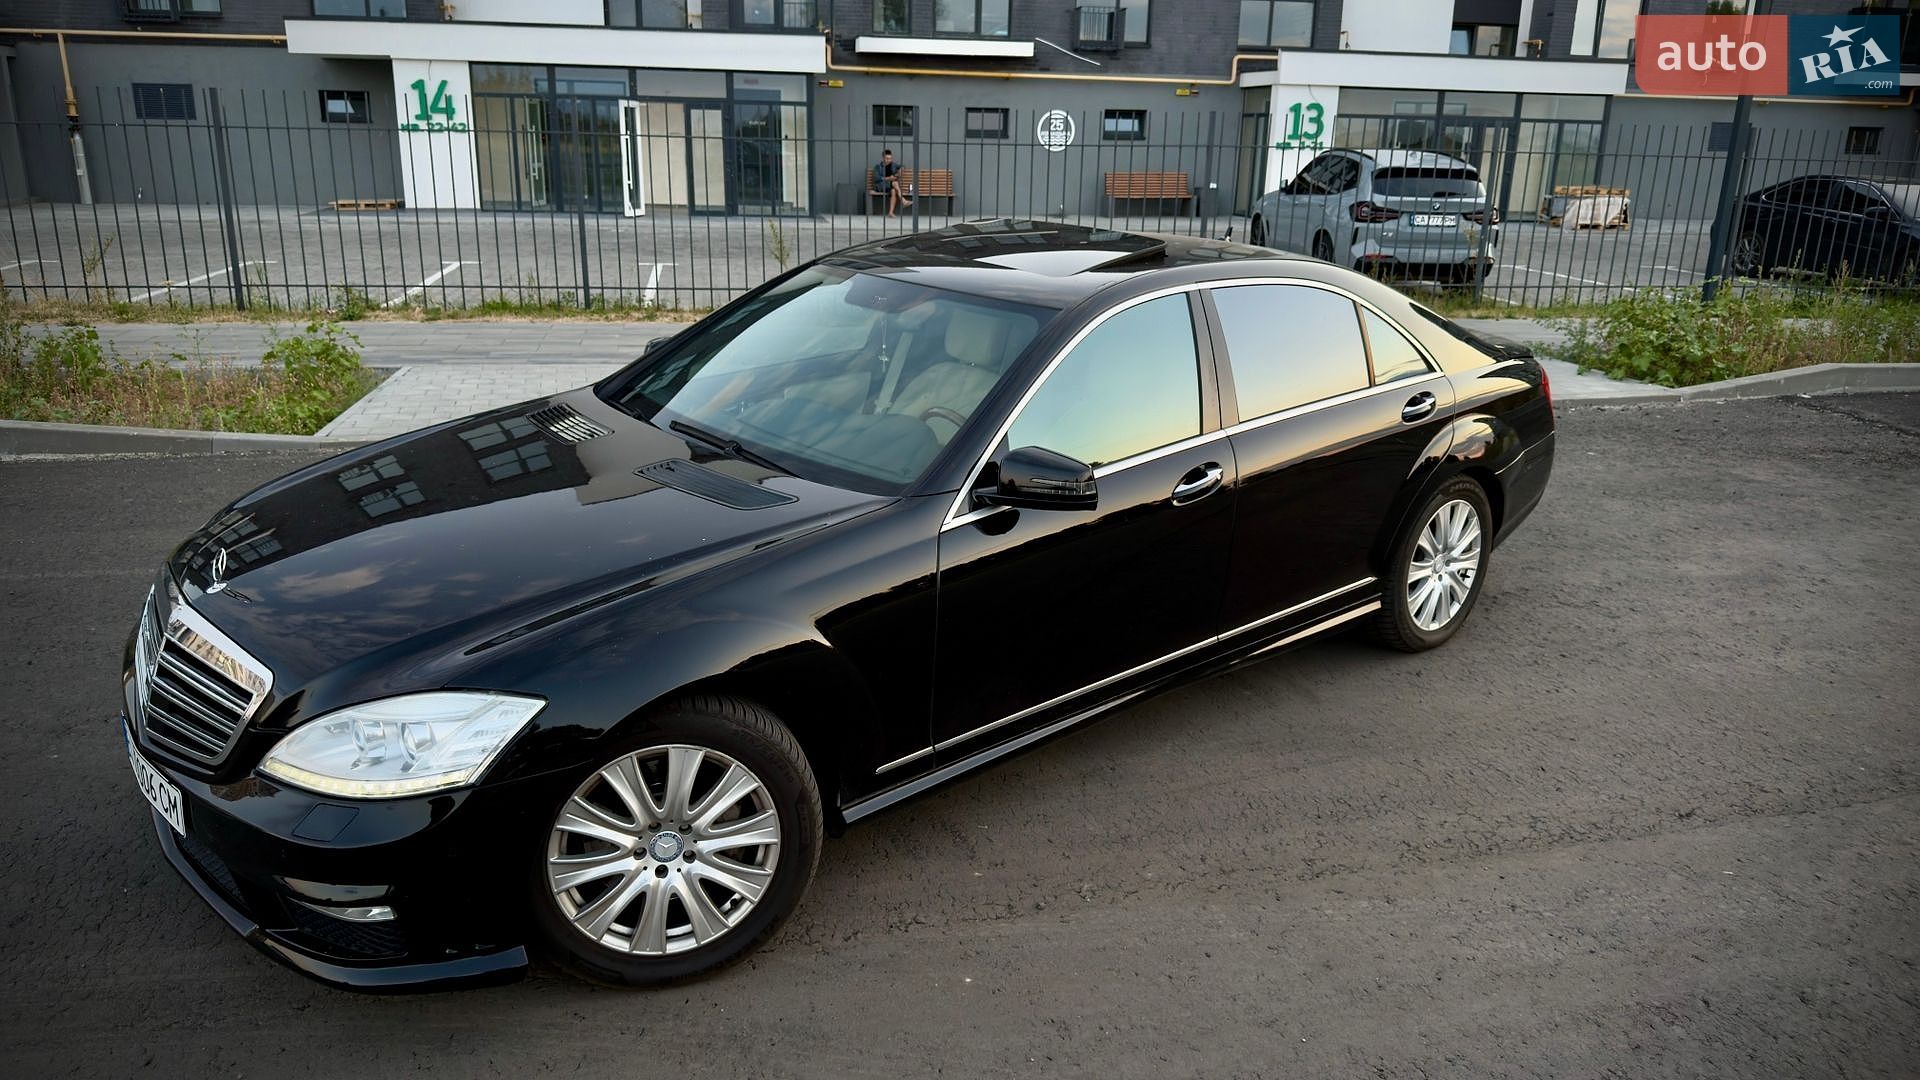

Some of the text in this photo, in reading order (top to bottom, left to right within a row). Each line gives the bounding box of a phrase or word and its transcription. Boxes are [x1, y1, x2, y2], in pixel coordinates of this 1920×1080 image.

[411, 79, 455, 120] 14
[1050, 119, 1064, 131] 25
[1287, 103, 1324, 139] 13
[159, 782, 180, 826] CM
